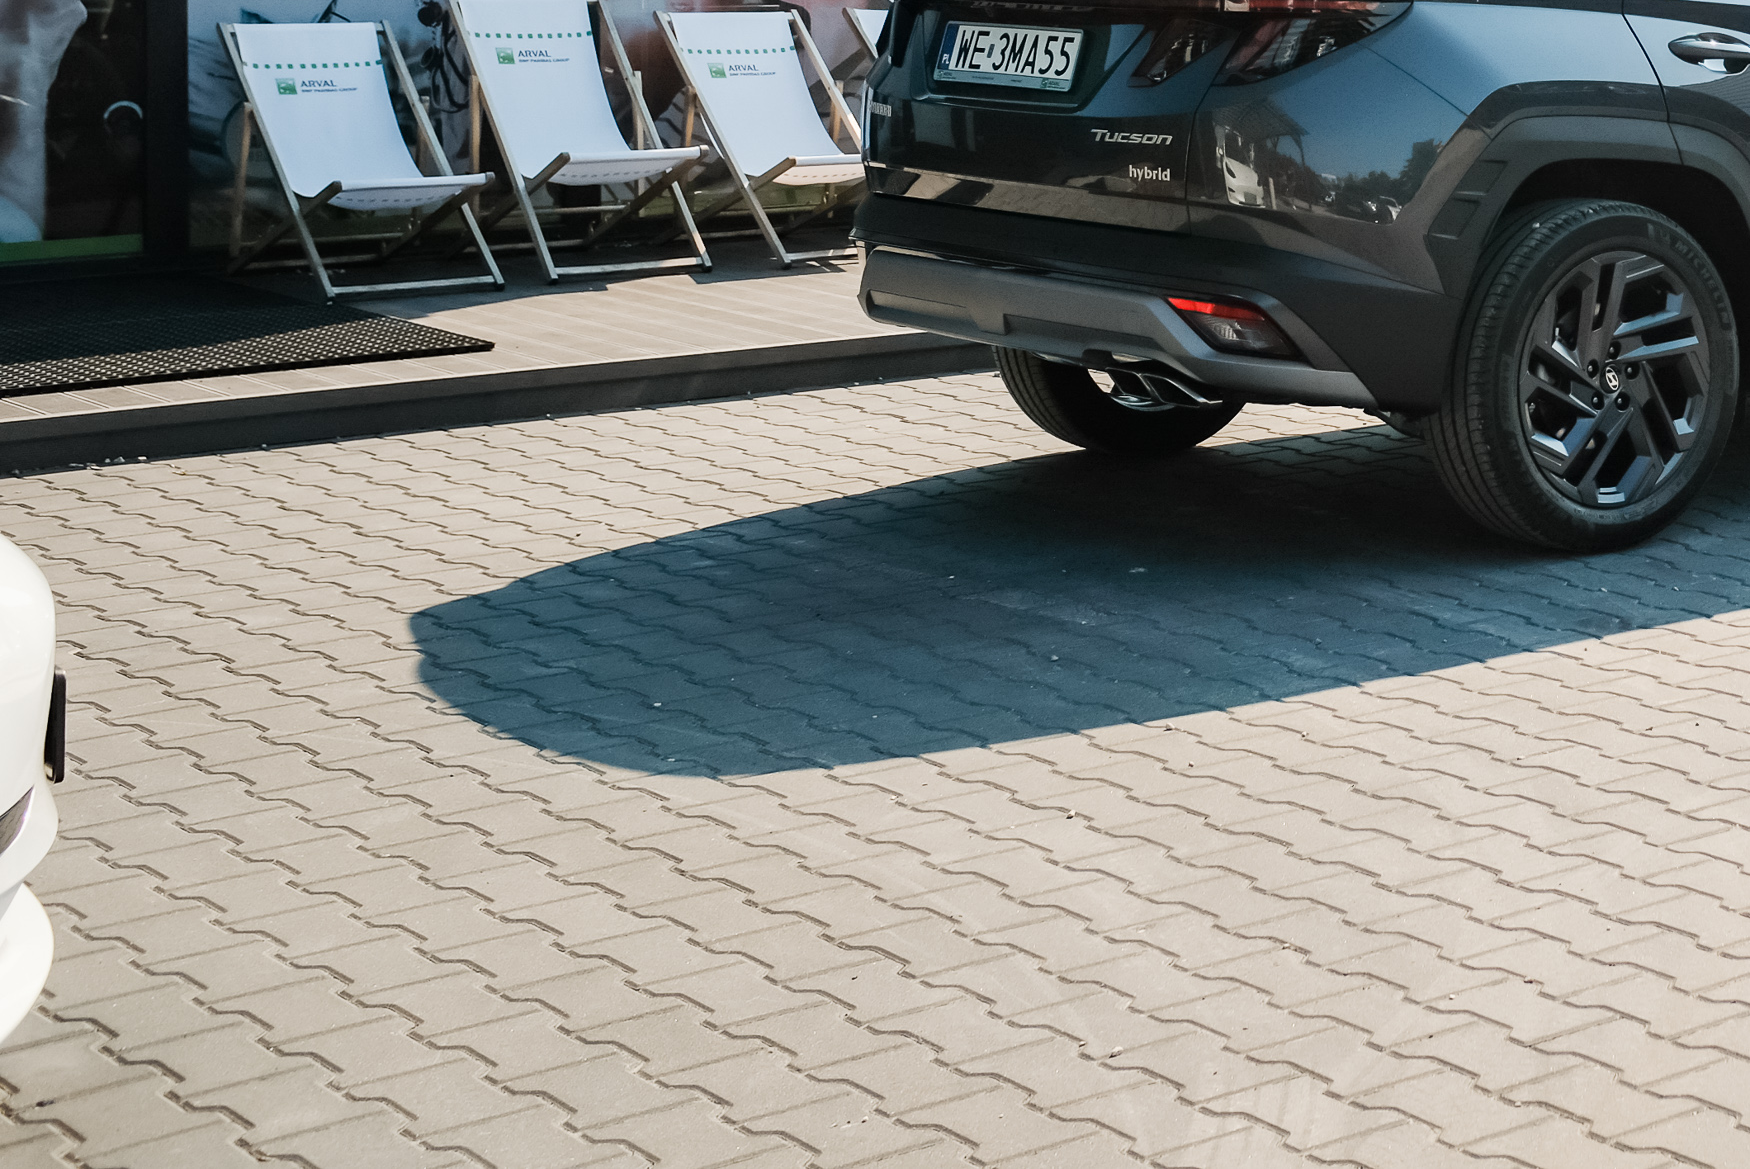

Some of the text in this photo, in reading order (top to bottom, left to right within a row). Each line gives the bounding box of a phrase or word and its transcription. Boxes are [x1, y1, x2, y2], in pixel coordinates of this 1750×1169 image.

[518, 49, 552, 58] ARVAL
[728, 64, 759, 72] ARVAL
[300, 79, 337, 88] ARVAL
[1128, 164, 1171, 182] hybrid
[1674, 240, 1730, 325] MICHELIN
